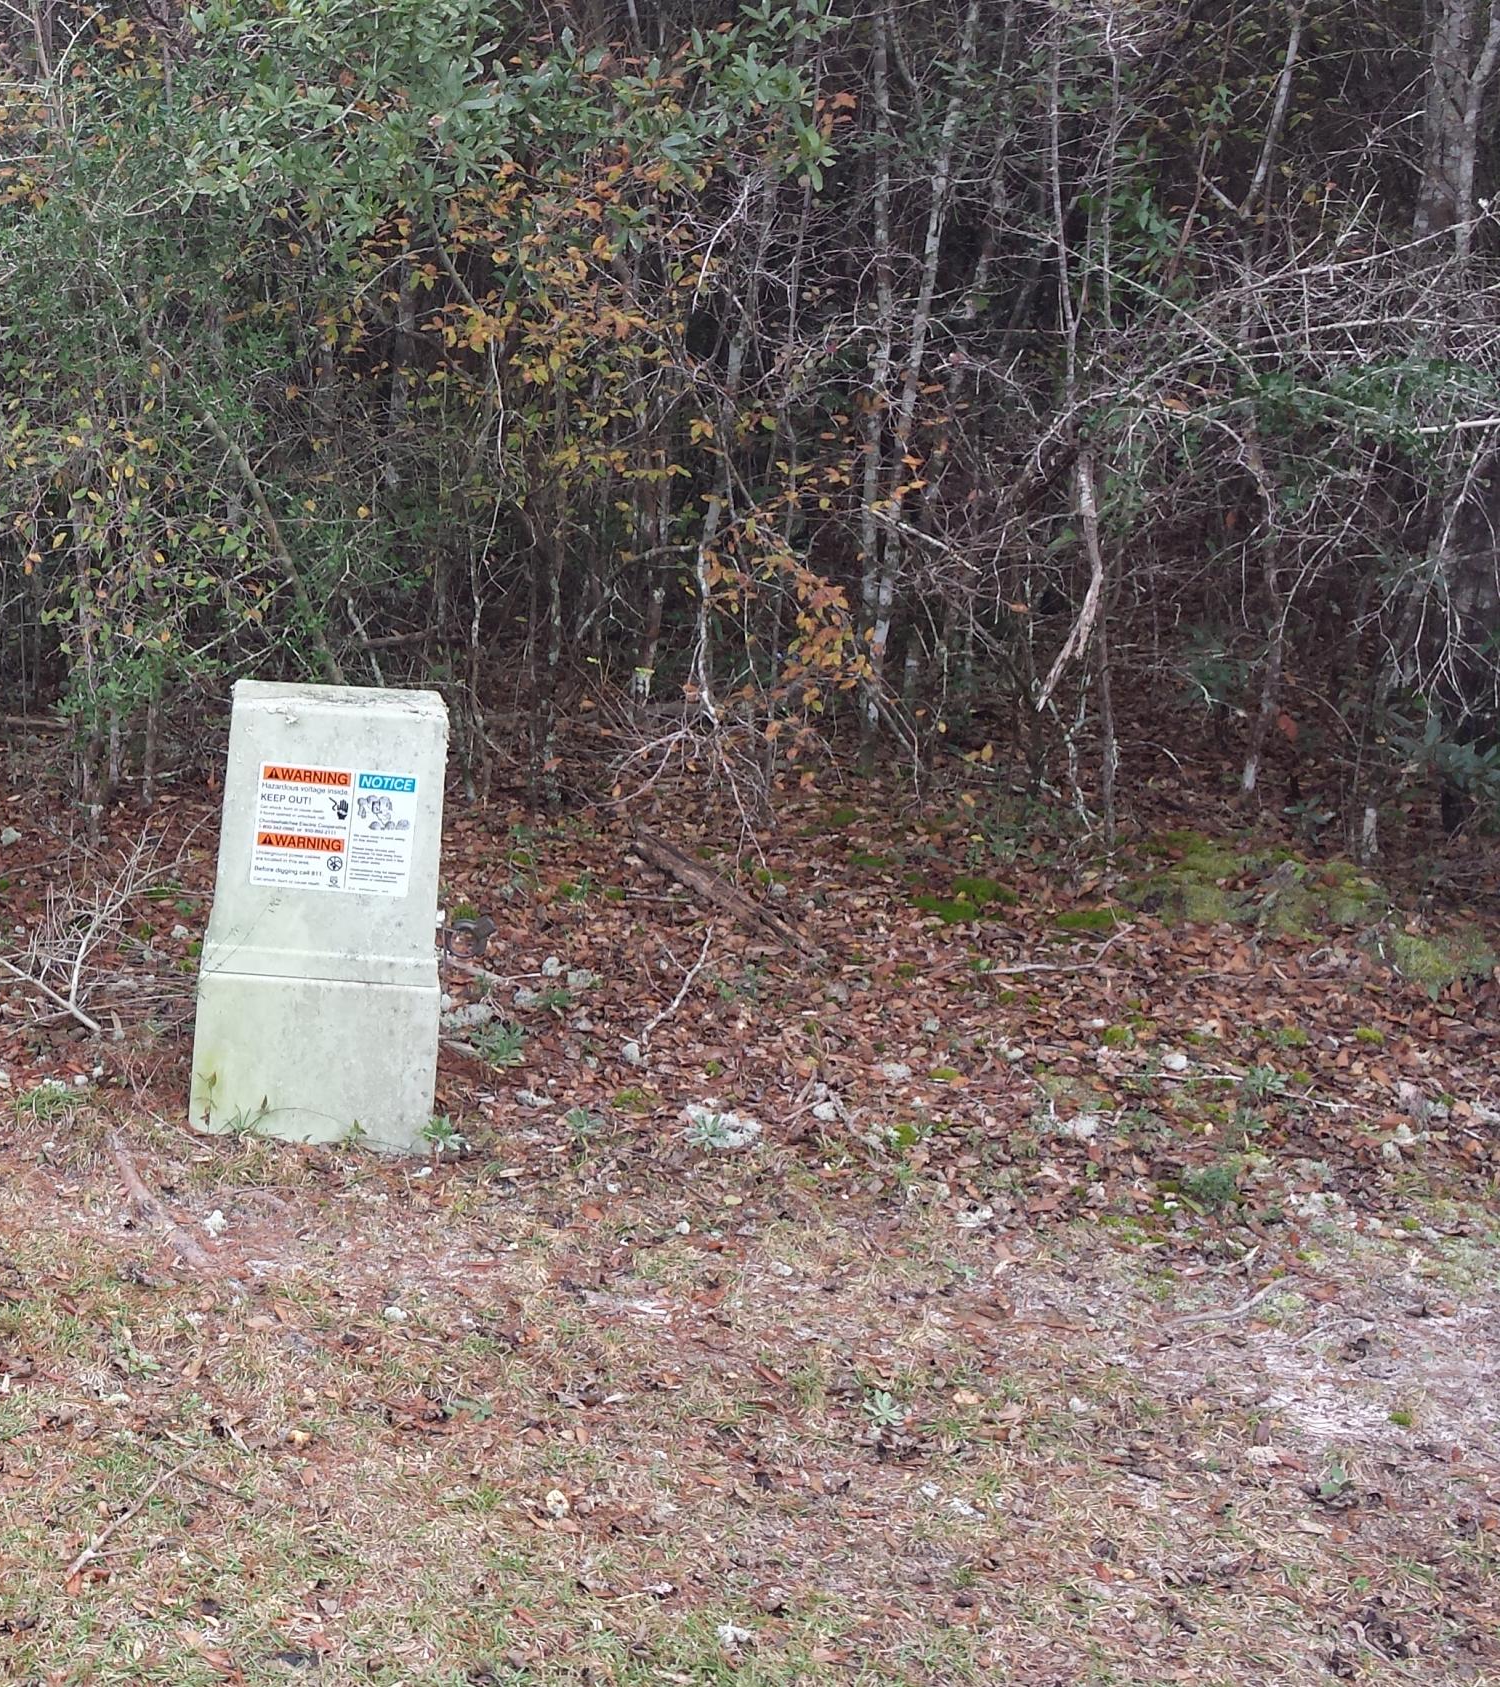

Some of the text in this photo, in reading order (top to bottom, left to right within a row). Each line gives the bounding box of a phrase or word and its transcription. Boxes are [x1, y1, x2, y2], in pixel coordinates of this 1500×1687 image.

[280, 767, 348, 785] WARNING
[361, 775, 414, 791] NOTICE
[261, 782, 299, 791] Hazardous
[300, 786, 325, 794] voltage
[260, 793, 312, 805] KEEP OUT!
[274, 834, 341, 851] WARNING
[275, 867, 298, 875] digging
